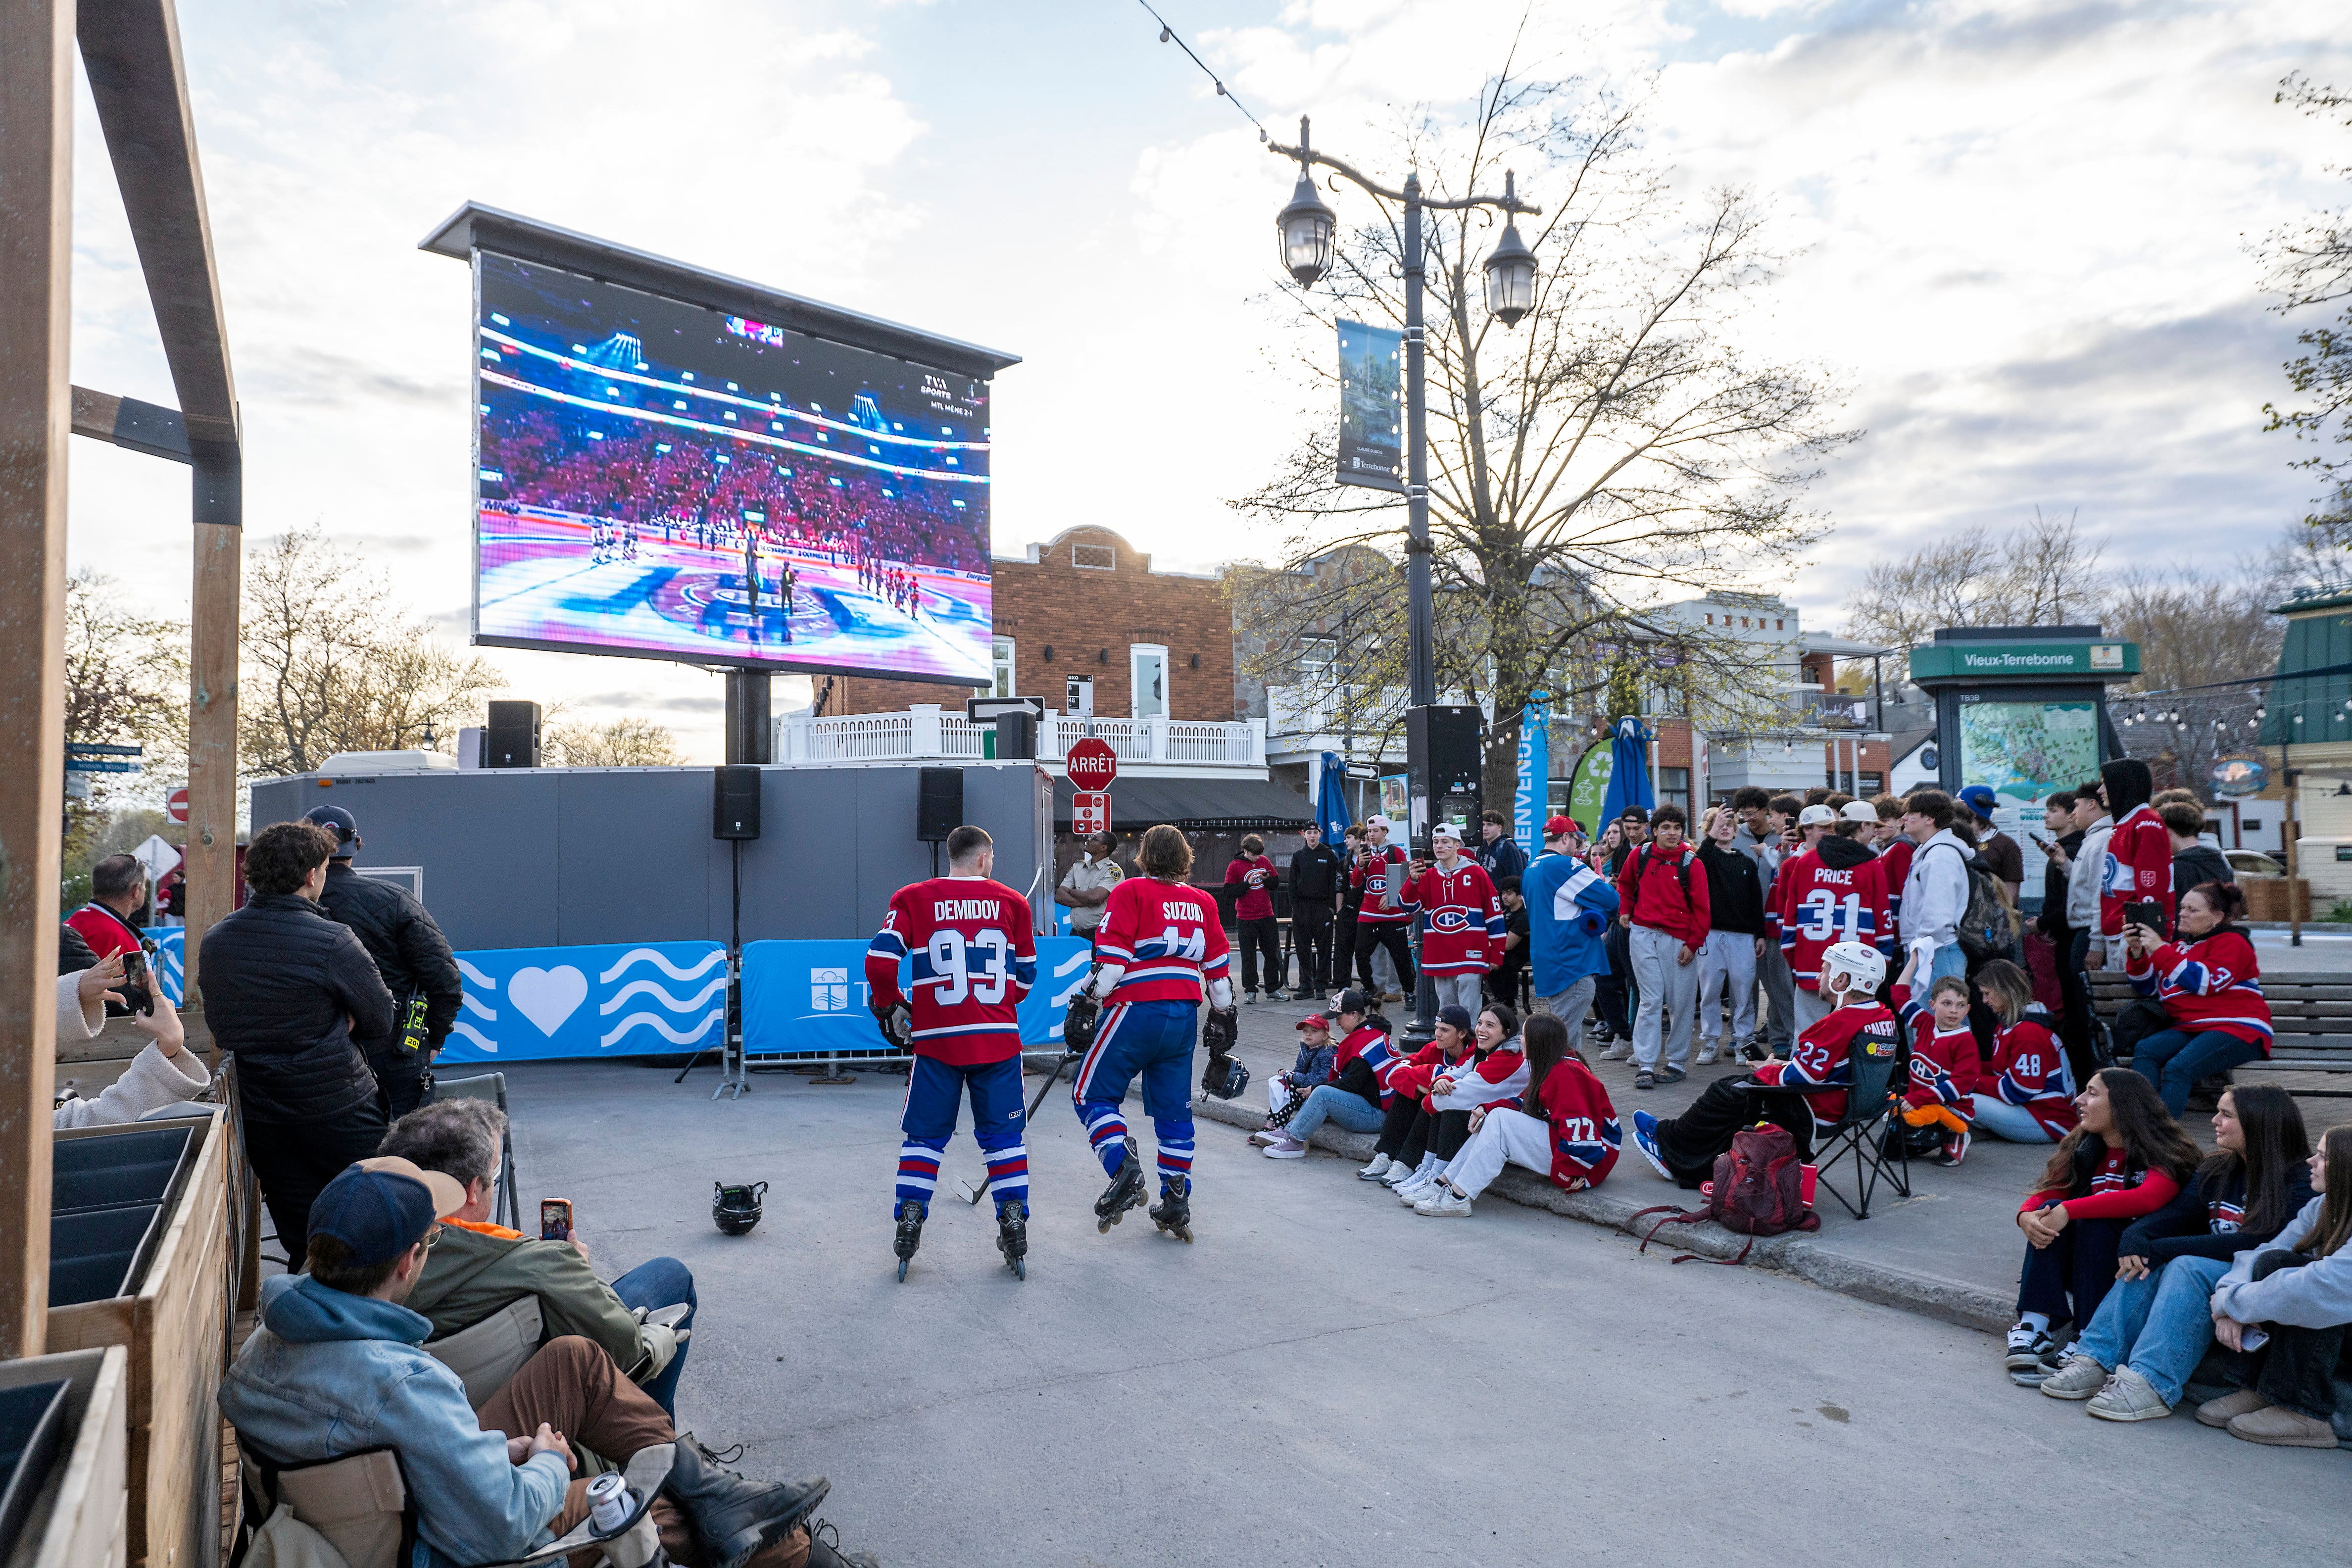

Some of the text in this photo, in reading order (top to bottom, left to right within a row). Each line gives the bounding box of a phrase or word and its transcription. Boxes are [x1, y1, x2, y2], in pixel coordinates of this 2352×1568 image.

[921, 386, 951, 399] SPORTS
[931, 401, 944, 410] MTL
[1361, 461, 1390, 472] Terrebonne
[1964, 653, 2073, 666] Vieux-Terrebonne
[1070, 753, 1114, 772] ARRÊT
[1463, 874, 1471, 886] C
[1814, 868, 1853, 885] PRICE
[934, 899, 1000, 922] DEMIDOV
[1162, 901, 1204, 923] SUZUKI
[1803, 889, 1861, 942] 31
[1163, 925, 1206, 962] 14
[927, 928, 1008, 1006] 93
[408, 1038, 419, 1047] 201
[1799, 1041, 1830, 1072] 22
[2015, 1053, 2040, 1077] 48
[1566, 1116, 1595, 1141] 77
